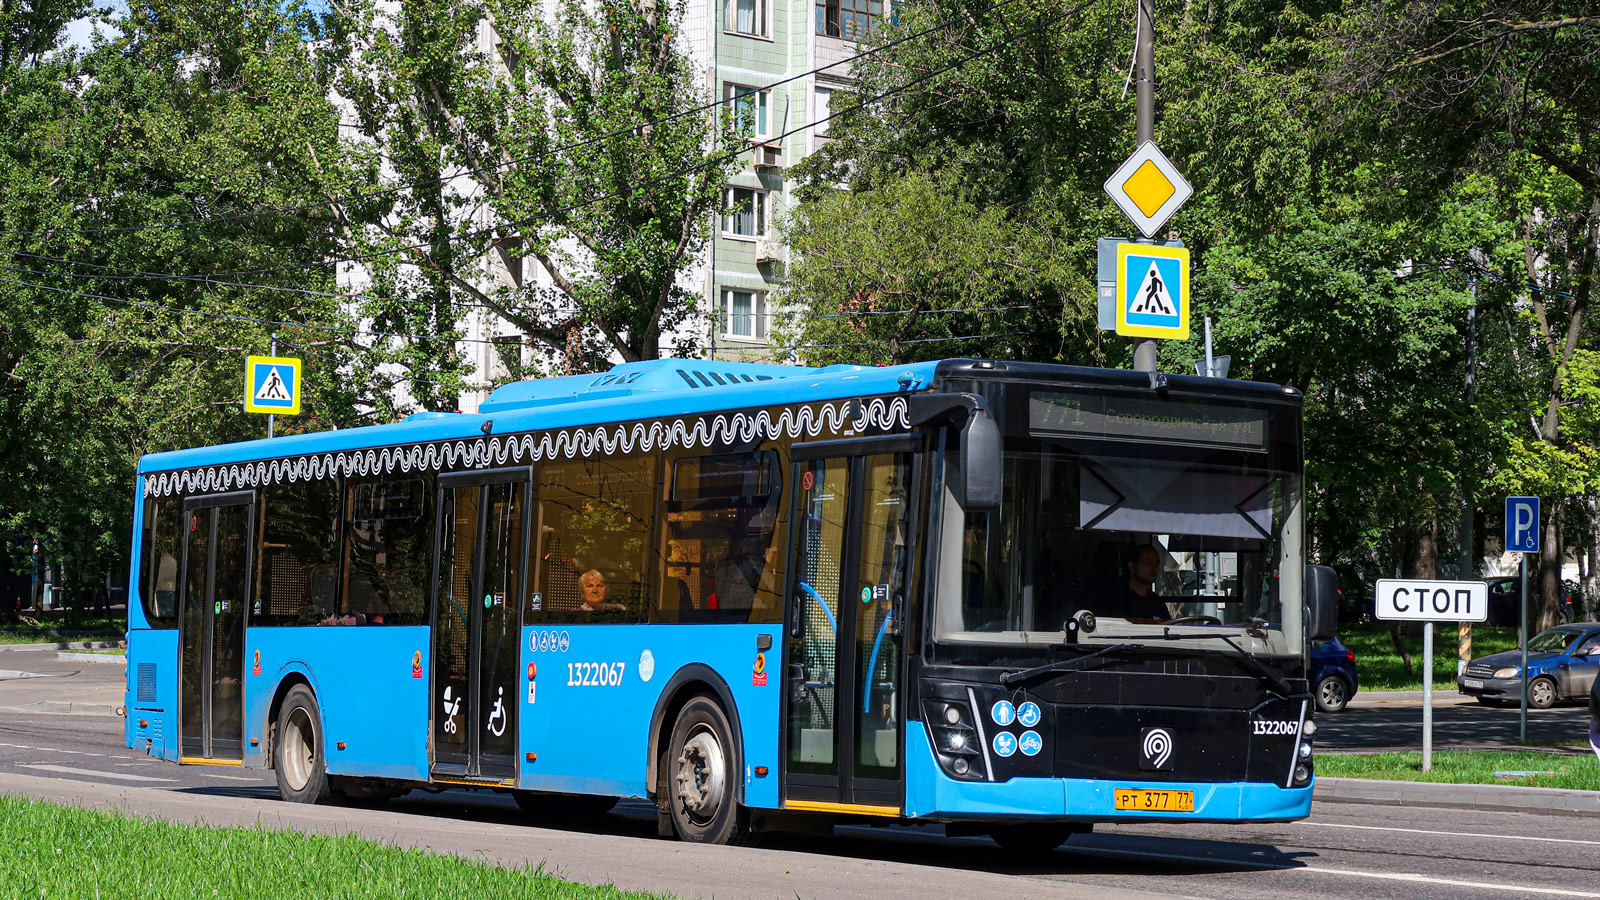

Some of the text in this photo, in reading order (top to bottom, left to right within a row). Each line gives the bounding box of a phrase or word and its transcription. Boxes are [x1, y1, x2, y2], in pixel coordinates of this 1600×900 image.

[1040, 397, 1085, 426] 771
[1514, 502, 1534, 546] P
[1392, 587, 1472, 614] СТОП
[567, 662, 626, 687] 1322067
[1253, 720, 1299, 735] 1322067
[1122, 792, 1189, 808] РТ 377 77
